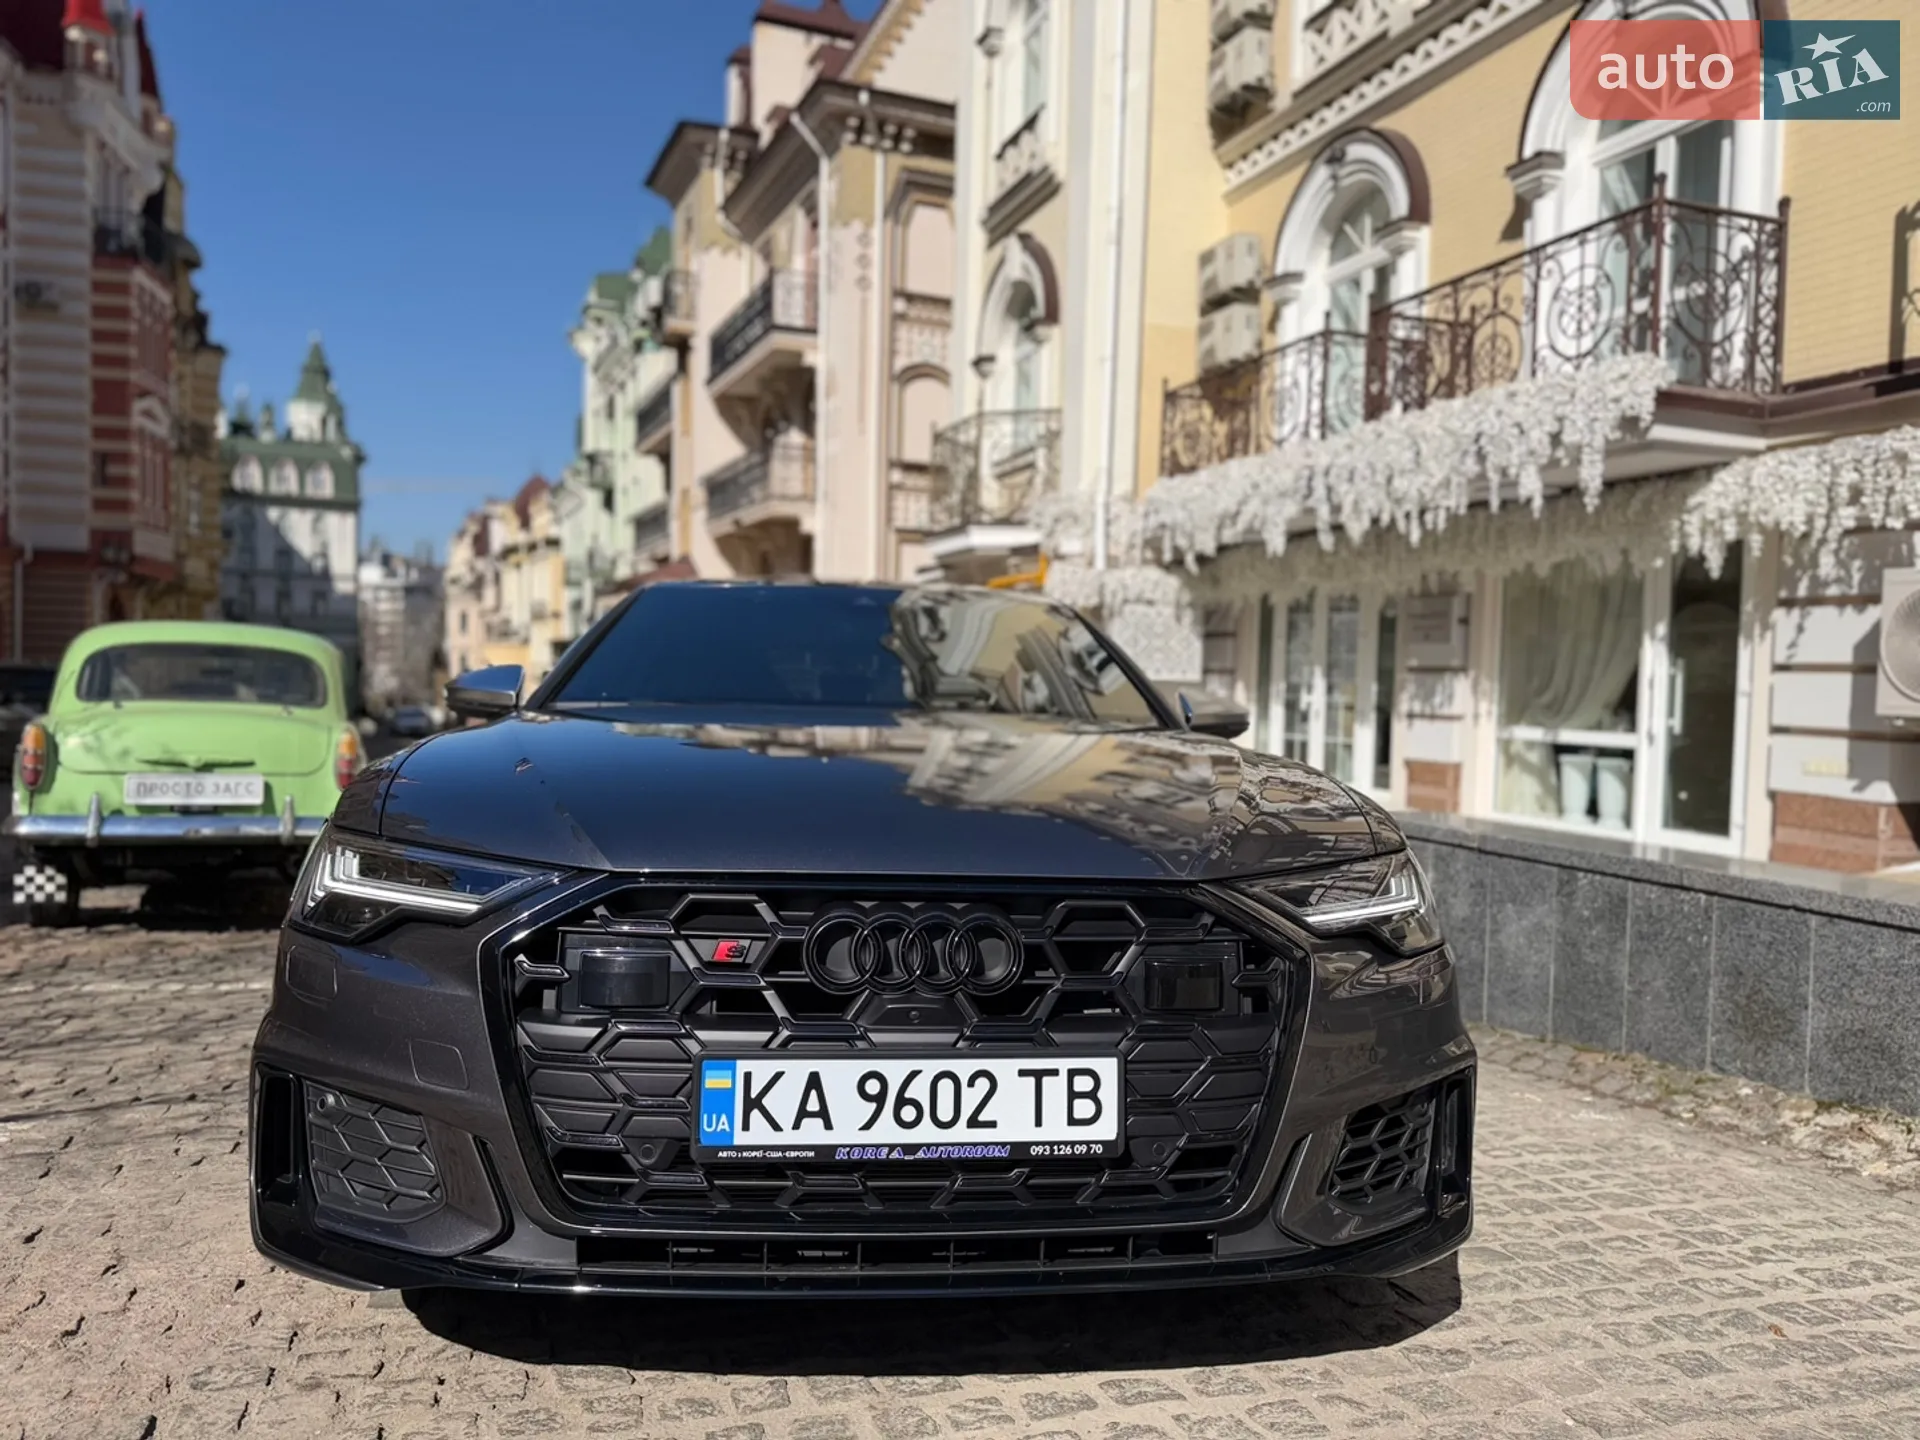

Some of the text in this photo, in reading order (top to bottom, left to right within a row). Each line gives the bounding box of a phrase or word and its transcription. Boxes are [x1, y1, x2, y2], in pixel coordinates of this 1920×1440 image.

[740, 1067, 1103, 1133] KA 9602 TB
[703, 1113, 730, 1133] UA
[1030, 1143, 1103, 1156] 093 126 09 70
